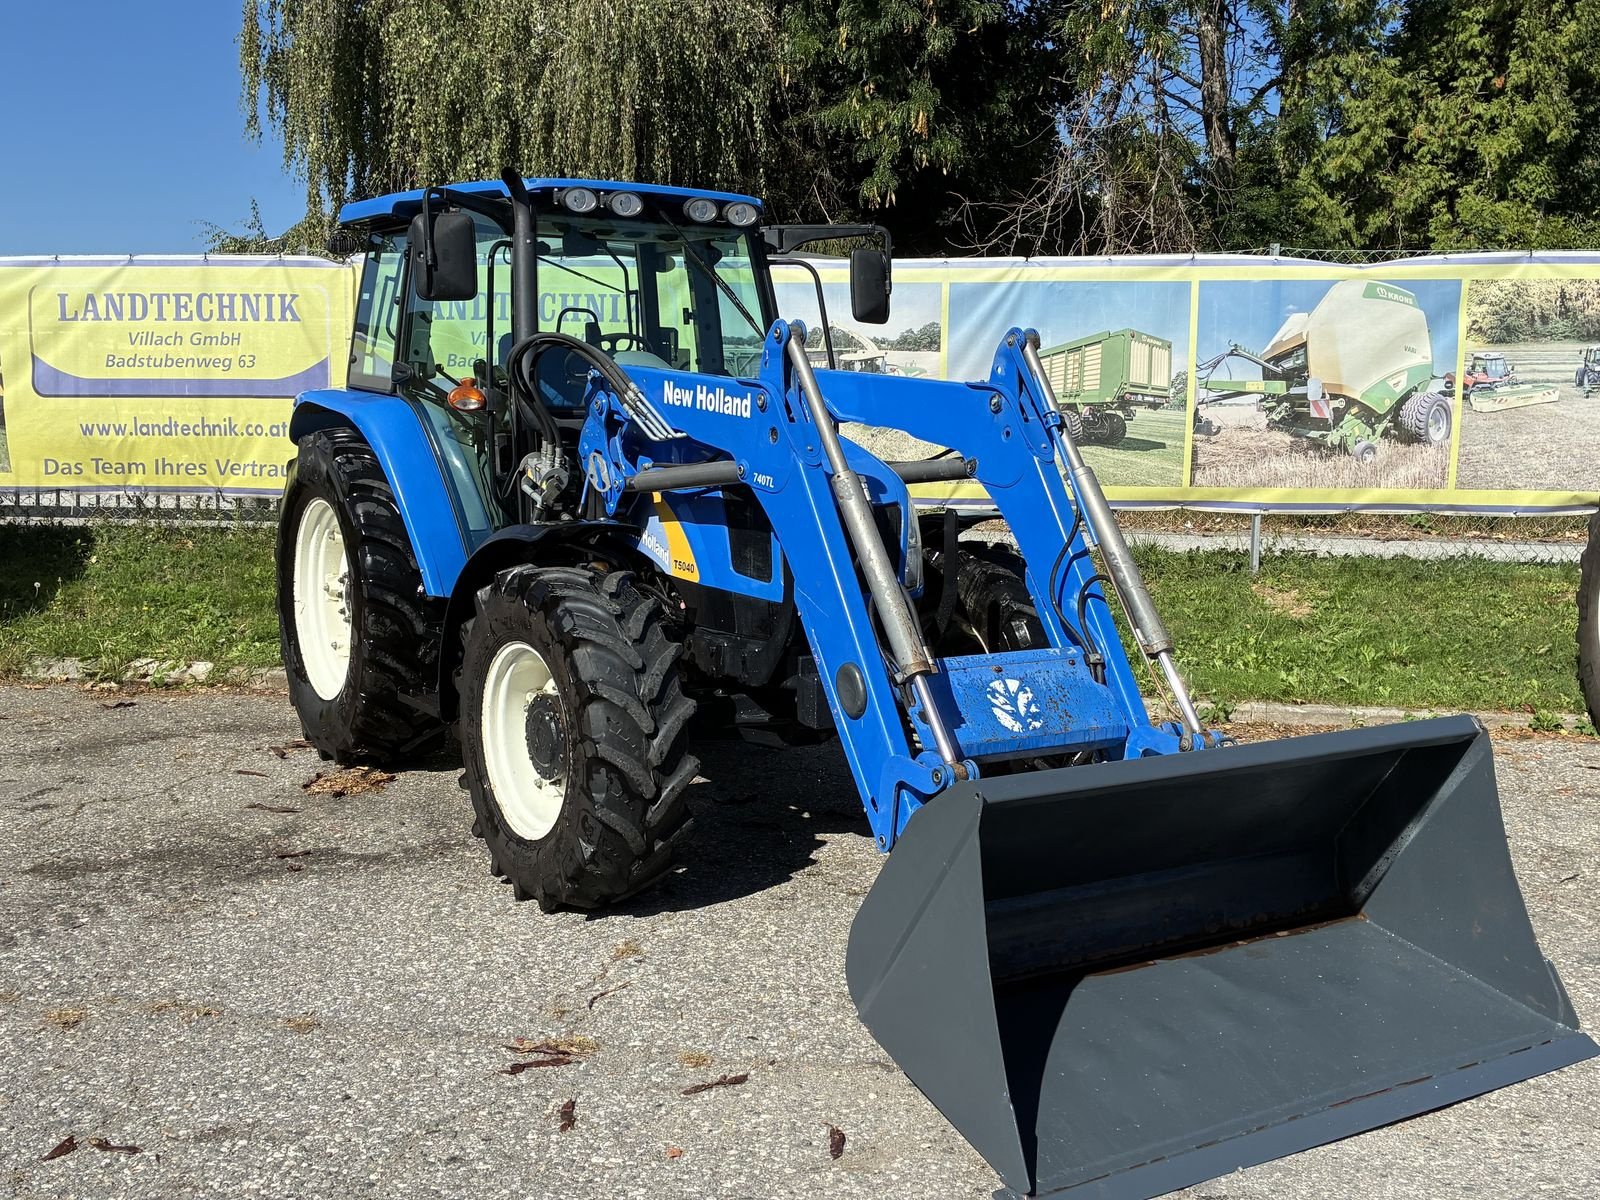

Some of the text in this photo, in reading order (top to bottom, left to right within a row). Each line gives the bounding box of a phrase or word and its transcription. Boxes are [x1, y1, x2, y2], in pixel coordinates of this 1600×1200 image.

[1388, 291, 1414, 305] KRONE
[57, 292, 301, 323] LANDTECHNIK
[128, 331, 241, 347] Villach GmbH
[105, 353, 256, 371] Badstubenweg 63
[663, 380, 751, 419] New Holland
[80, 416, 287, 437] www.landtechnik.co.at
[44, 458, 83, 476] Das
[90, 458, 146, 475] Team
[154, 457, 207, 475] Ihres
[753, 472, 774, 488] 740TL
[673, 559, 695, 574] T5040
